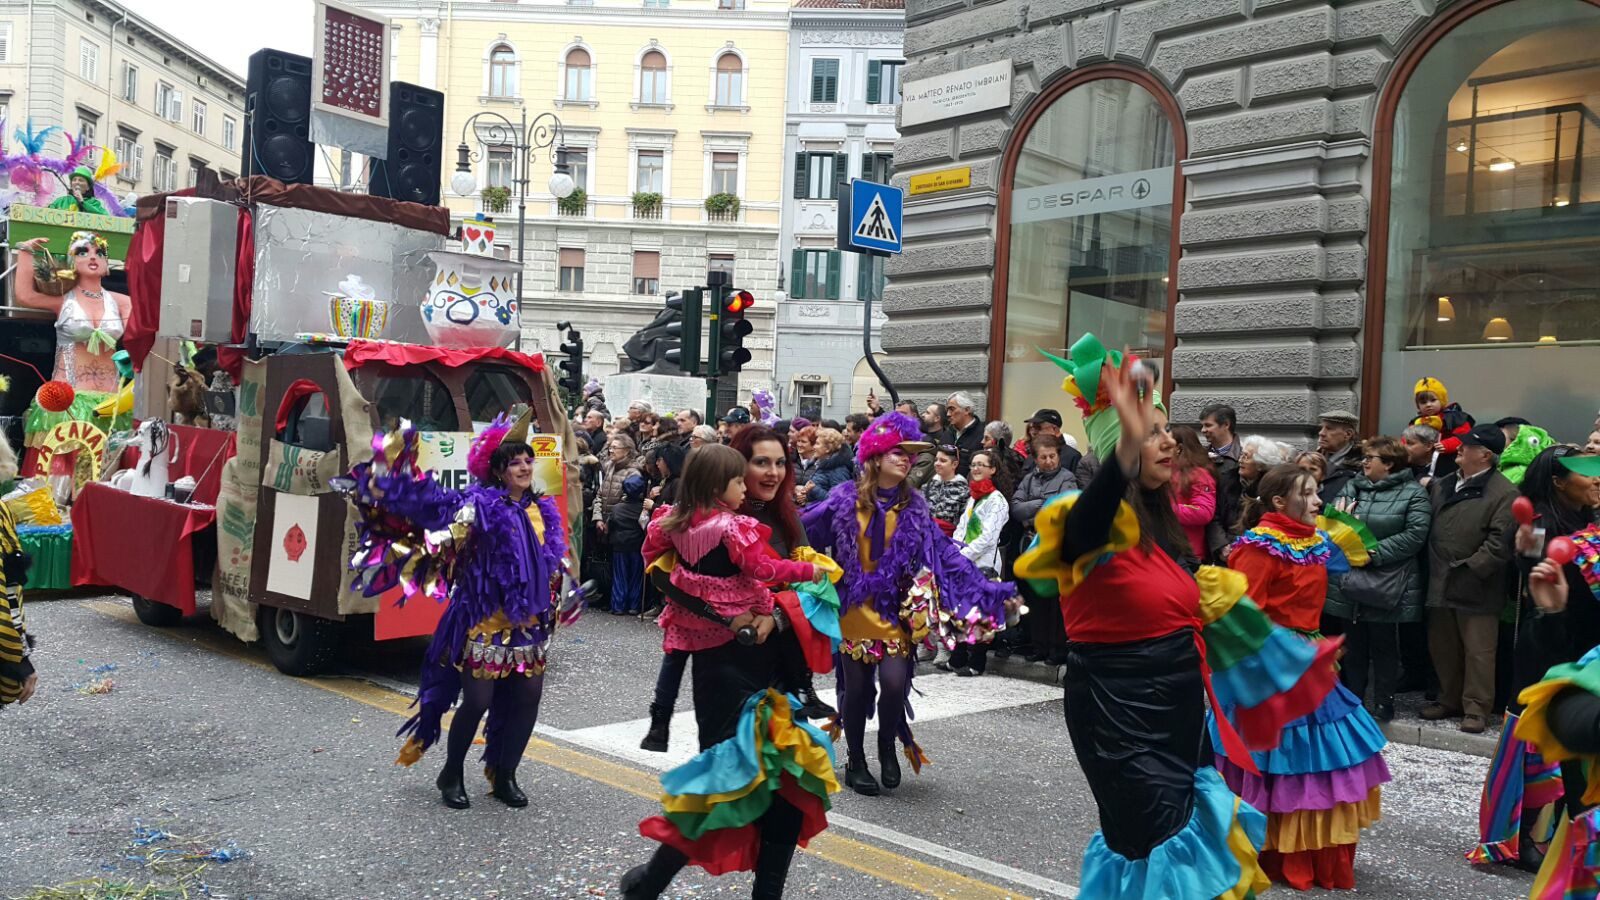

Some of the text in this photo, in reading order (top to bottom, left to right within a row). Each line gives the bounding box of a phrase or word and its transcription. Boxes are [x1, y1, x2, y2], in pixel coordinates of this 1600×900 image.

[919, 87, 943, 100] MATTEO
[946, 81, 973, 94] RENATO
[975, 73, 1008, 87] IMBRIANI
[1027, 185, 1124, 211] DESPAR
